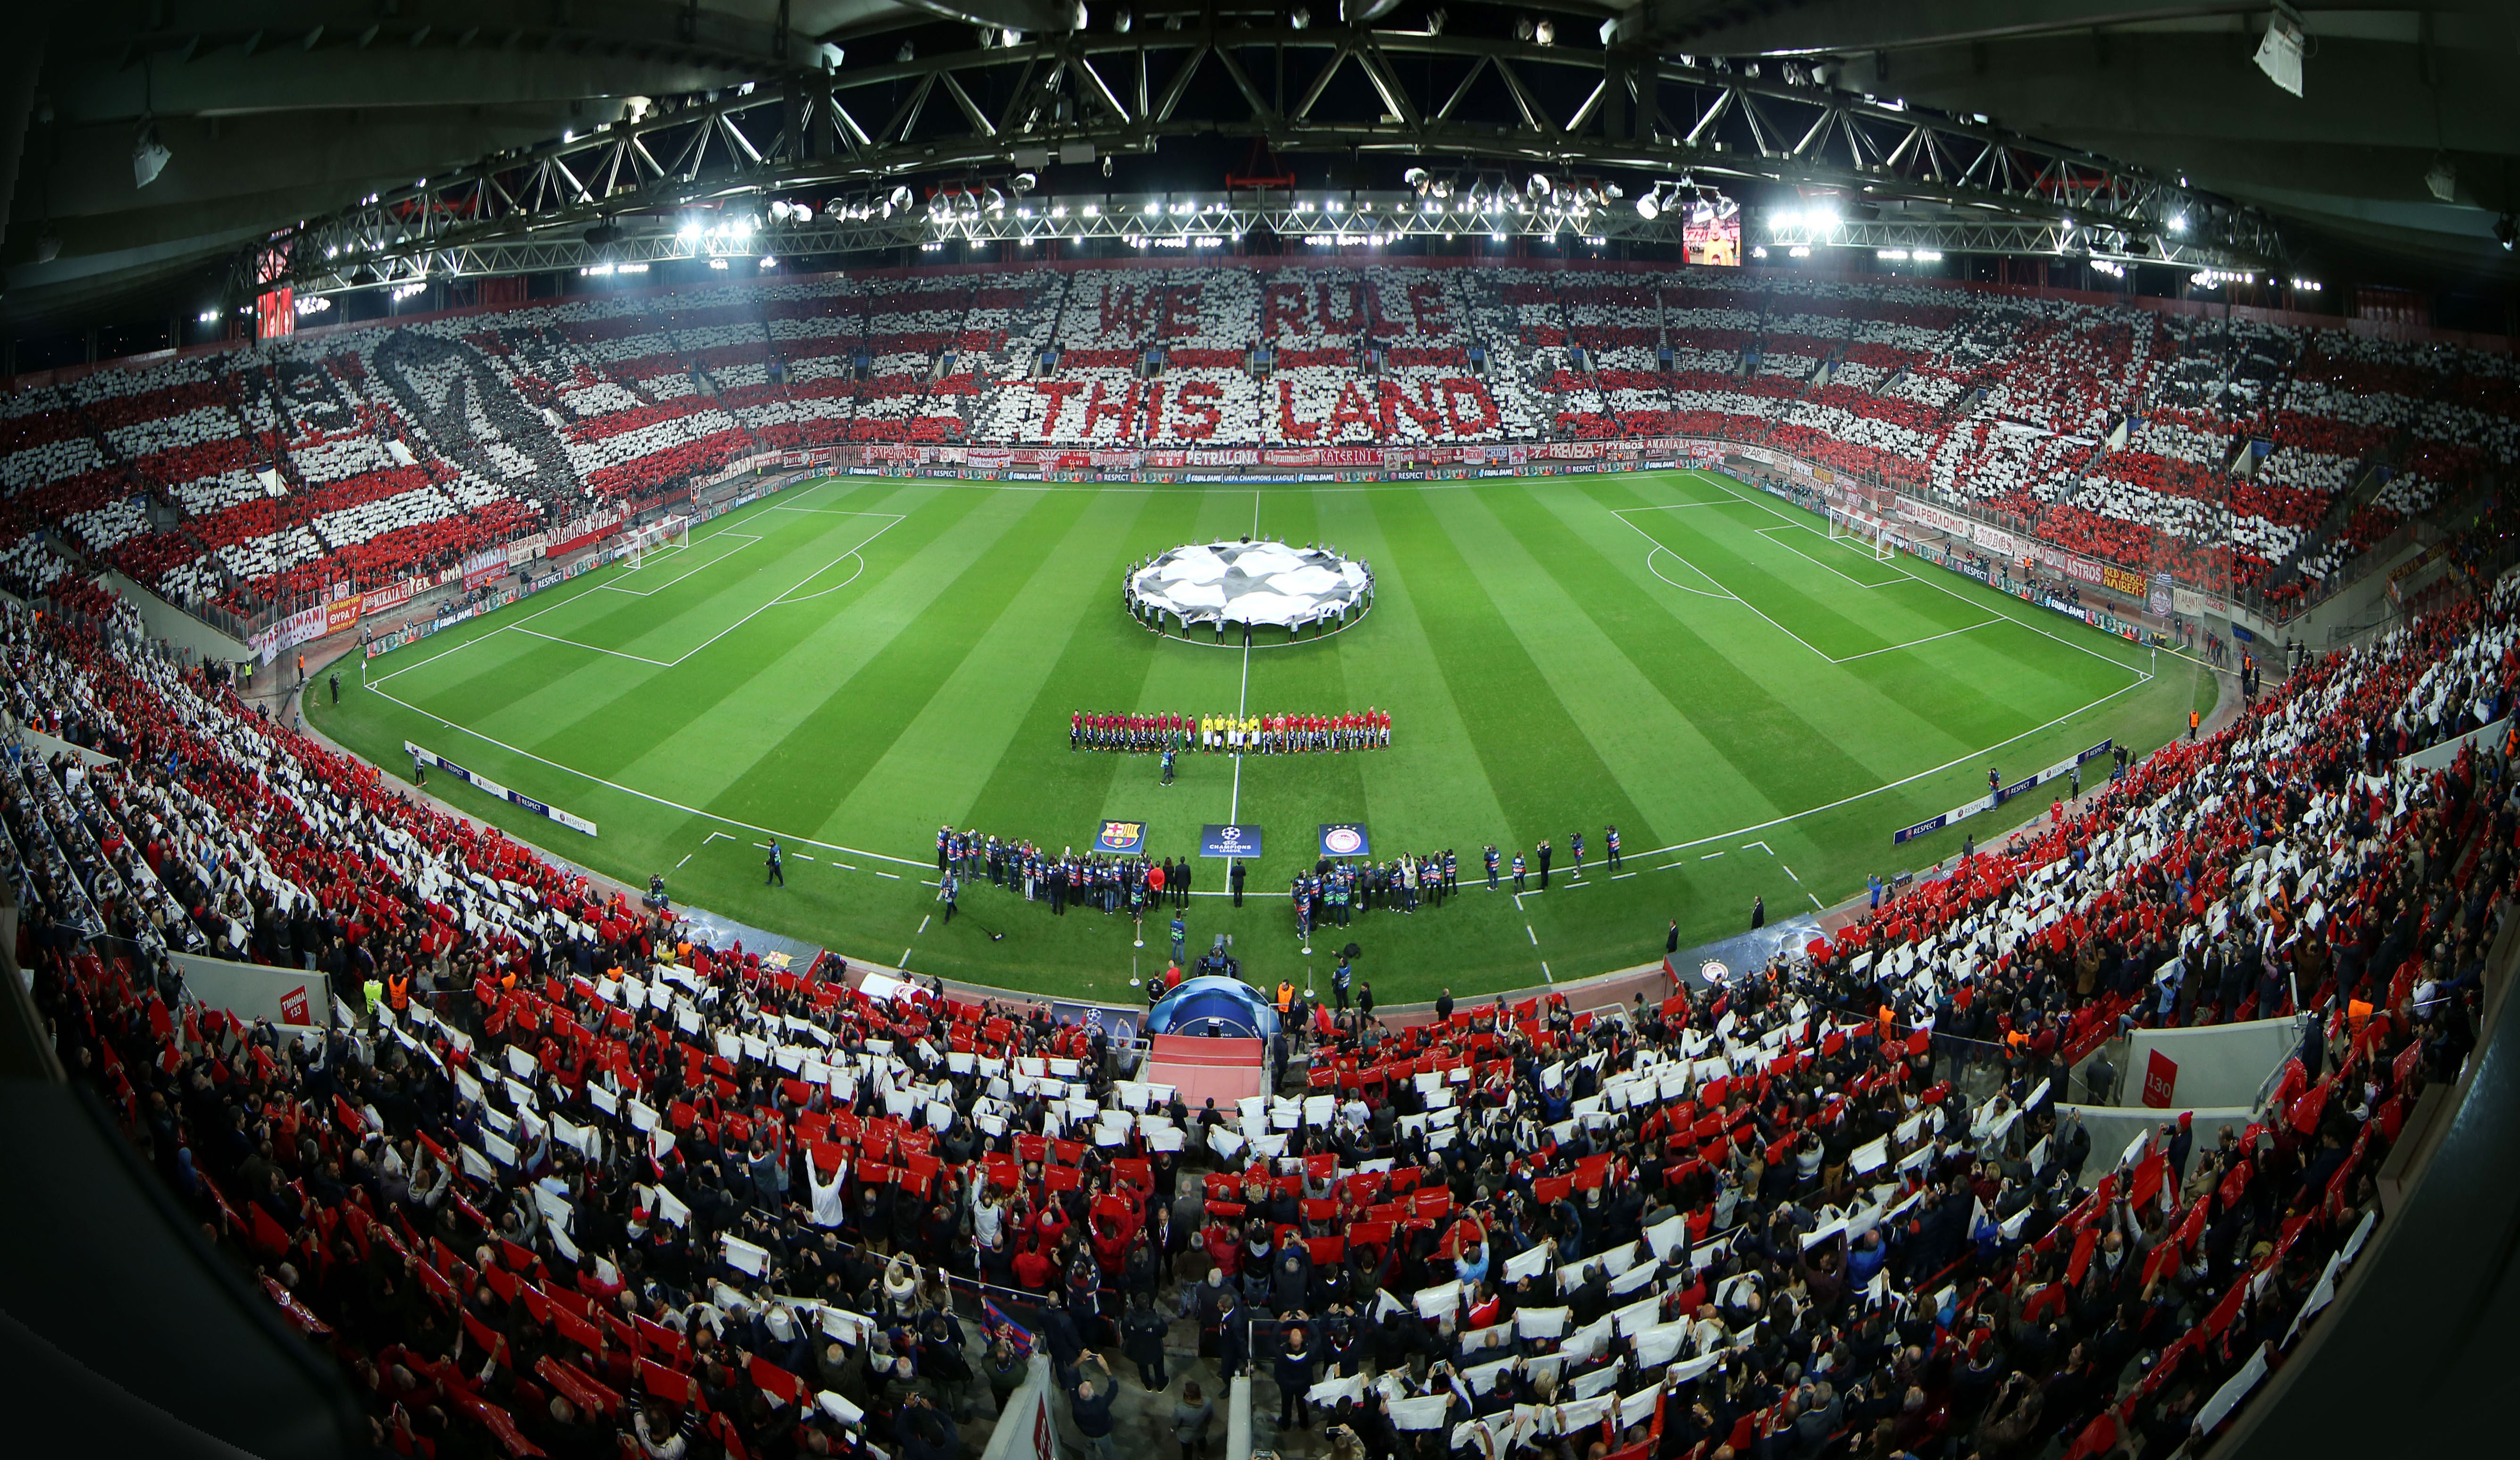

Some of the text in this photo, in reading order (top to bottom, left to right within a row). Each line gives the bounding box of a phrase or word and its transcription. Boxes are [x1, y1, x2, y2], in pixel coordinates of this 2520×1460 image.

[1099, 283, 1451, 338] WE RULE
[1037, 379, 1500, 440] THIS LAND
[784, 453, 829, 466] Porto Leone
[1186, 450, 1260, 466] PETRALONA
[1321, 451, 1371, 462] KATERINI
[1487, 448, 1507, 457] CHIOS
[790, 473, 804, 483] RESPECT
[1104, 473, 1129, 481] RESPECT
[1724, 467, 1736, 477] RESPECT
[510, 532, 543, 553] ΠΕΙΡΑΙΑΣ
[464, 547, 507, 575] KAMINIA
[510, 554, 519, 564] FAN
[519, 550, 530, 561] CLUB
[531, 546, 542, 558] GTE
[1964, 564, 1987, 581] RESPECT
[2067, 558, 2101, 583] ASTROS
[2104, 565, 2147, 587] RED REBELS
[538, 572, 561, 589] RESPECT
[330, 606, 357, 624] ΘΥΡΑ 7
[2090, 744, 2106, 756] RESPECT
[448, 764, 464, 777] RESPECT
[2052, 762, 2069, 775] RESPECT
[482, 780, 499, 793] RESPECT
[2010, 781, 2030, 794] RESPECT
[521, 798, 541, 812] RESPECT
[1964, 801, 1985, 814] RESPECT
[566, 816, 586, 830] RESPECT
[1913, 821, 1937, 835] RESPECT
[282, 991, 306, 1011] ΤΜΗΜΑ
[291, 1005, 301, 1018] 133
[2148, 1073, 2171, 1099] 130
